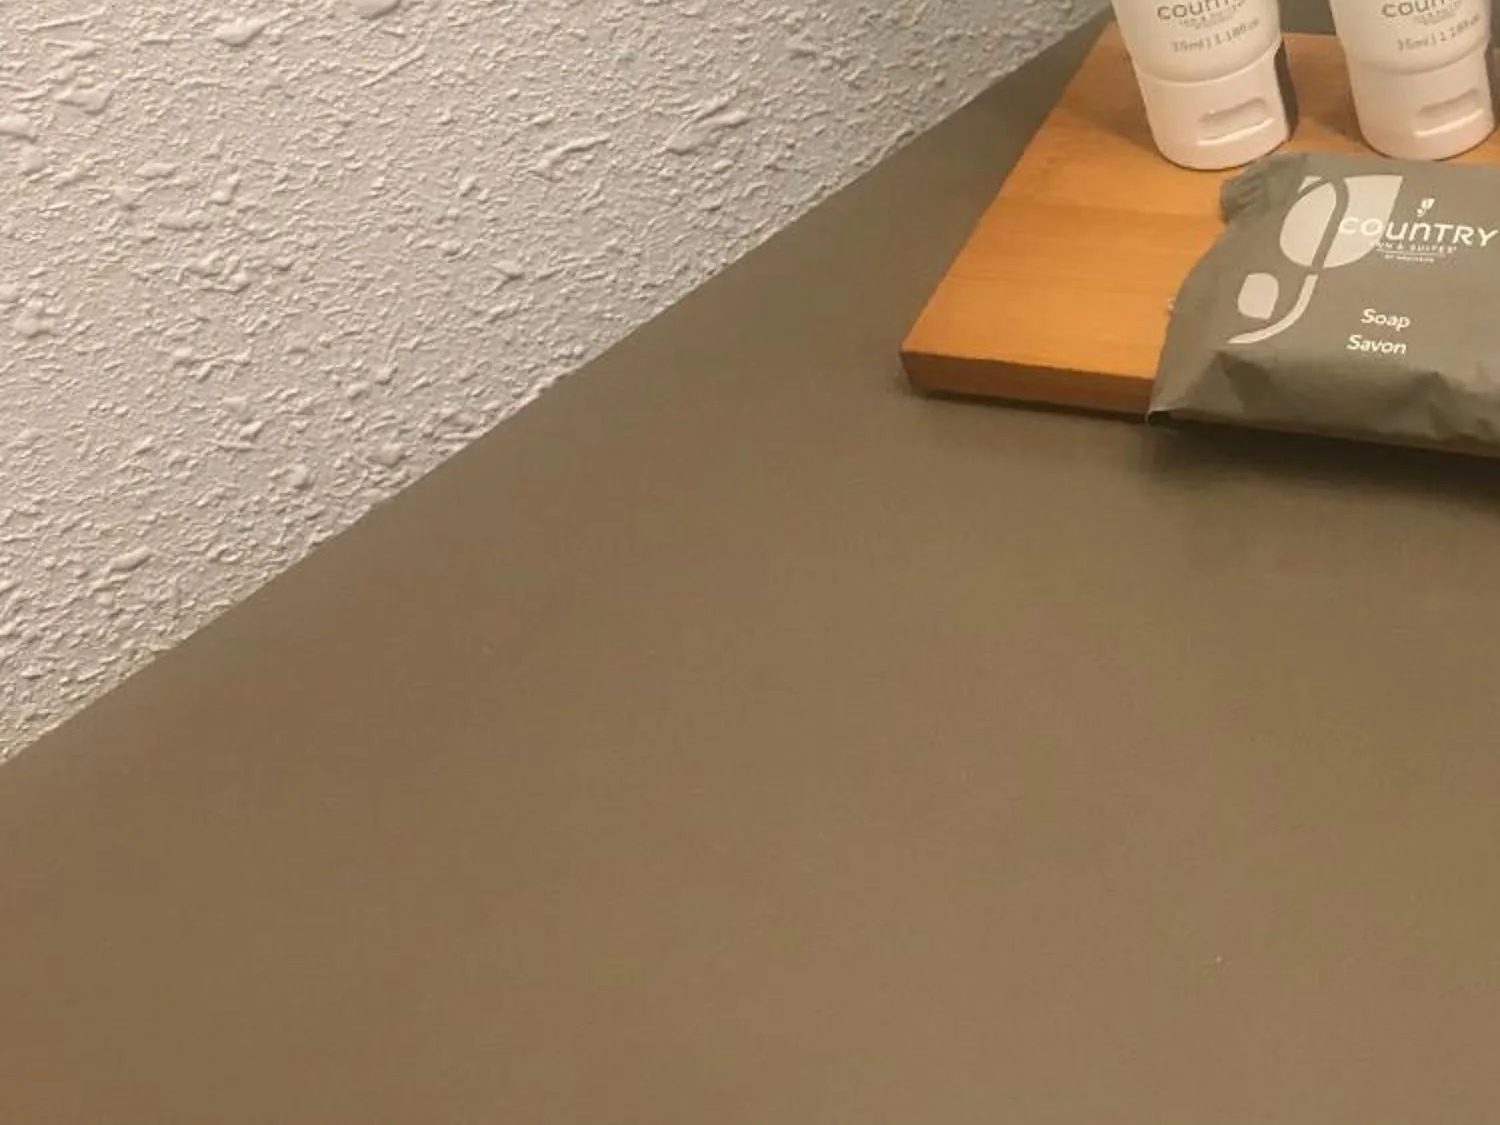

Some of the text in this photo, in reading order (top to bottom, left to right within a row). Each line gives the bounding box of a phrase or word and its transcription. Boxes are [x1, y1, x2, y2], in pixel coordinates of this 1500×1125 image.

[1338, 216, 1499, 247] COUNTRY
[1361, 308, 1410, 332] Soap
[1347, 334, 1407, 355] Savon
